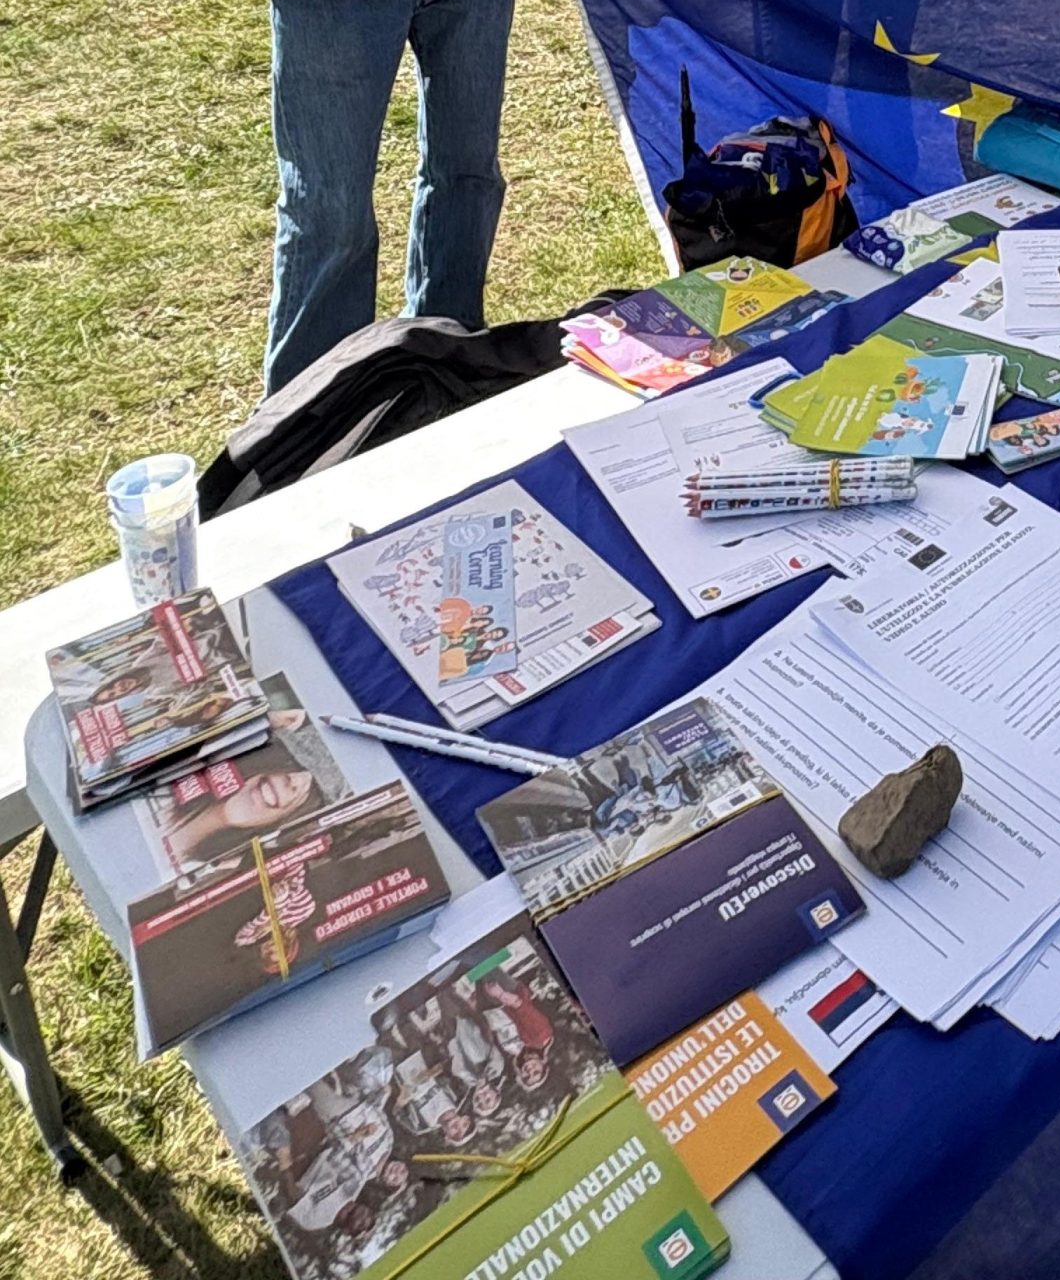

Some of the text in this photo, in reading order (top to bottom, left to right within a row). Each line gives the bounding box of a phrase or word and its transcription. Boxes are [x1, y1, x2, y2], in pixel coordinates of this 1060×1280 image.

[883, 733, 918, 761] pomemb
[998, 821, 1019, 838] med
[377, 878, 428, 912] PORTALE
[718, 853, 816, 921] DiscoverEU
[949, 878, 960, 890] in
[735, 1020, 764, 1047] LE
[693, 1041, 781, 1118] TIROCINI
[589, 1161, 662, 1232] CAMPI
[560, 1220, 591, 1257] DI
